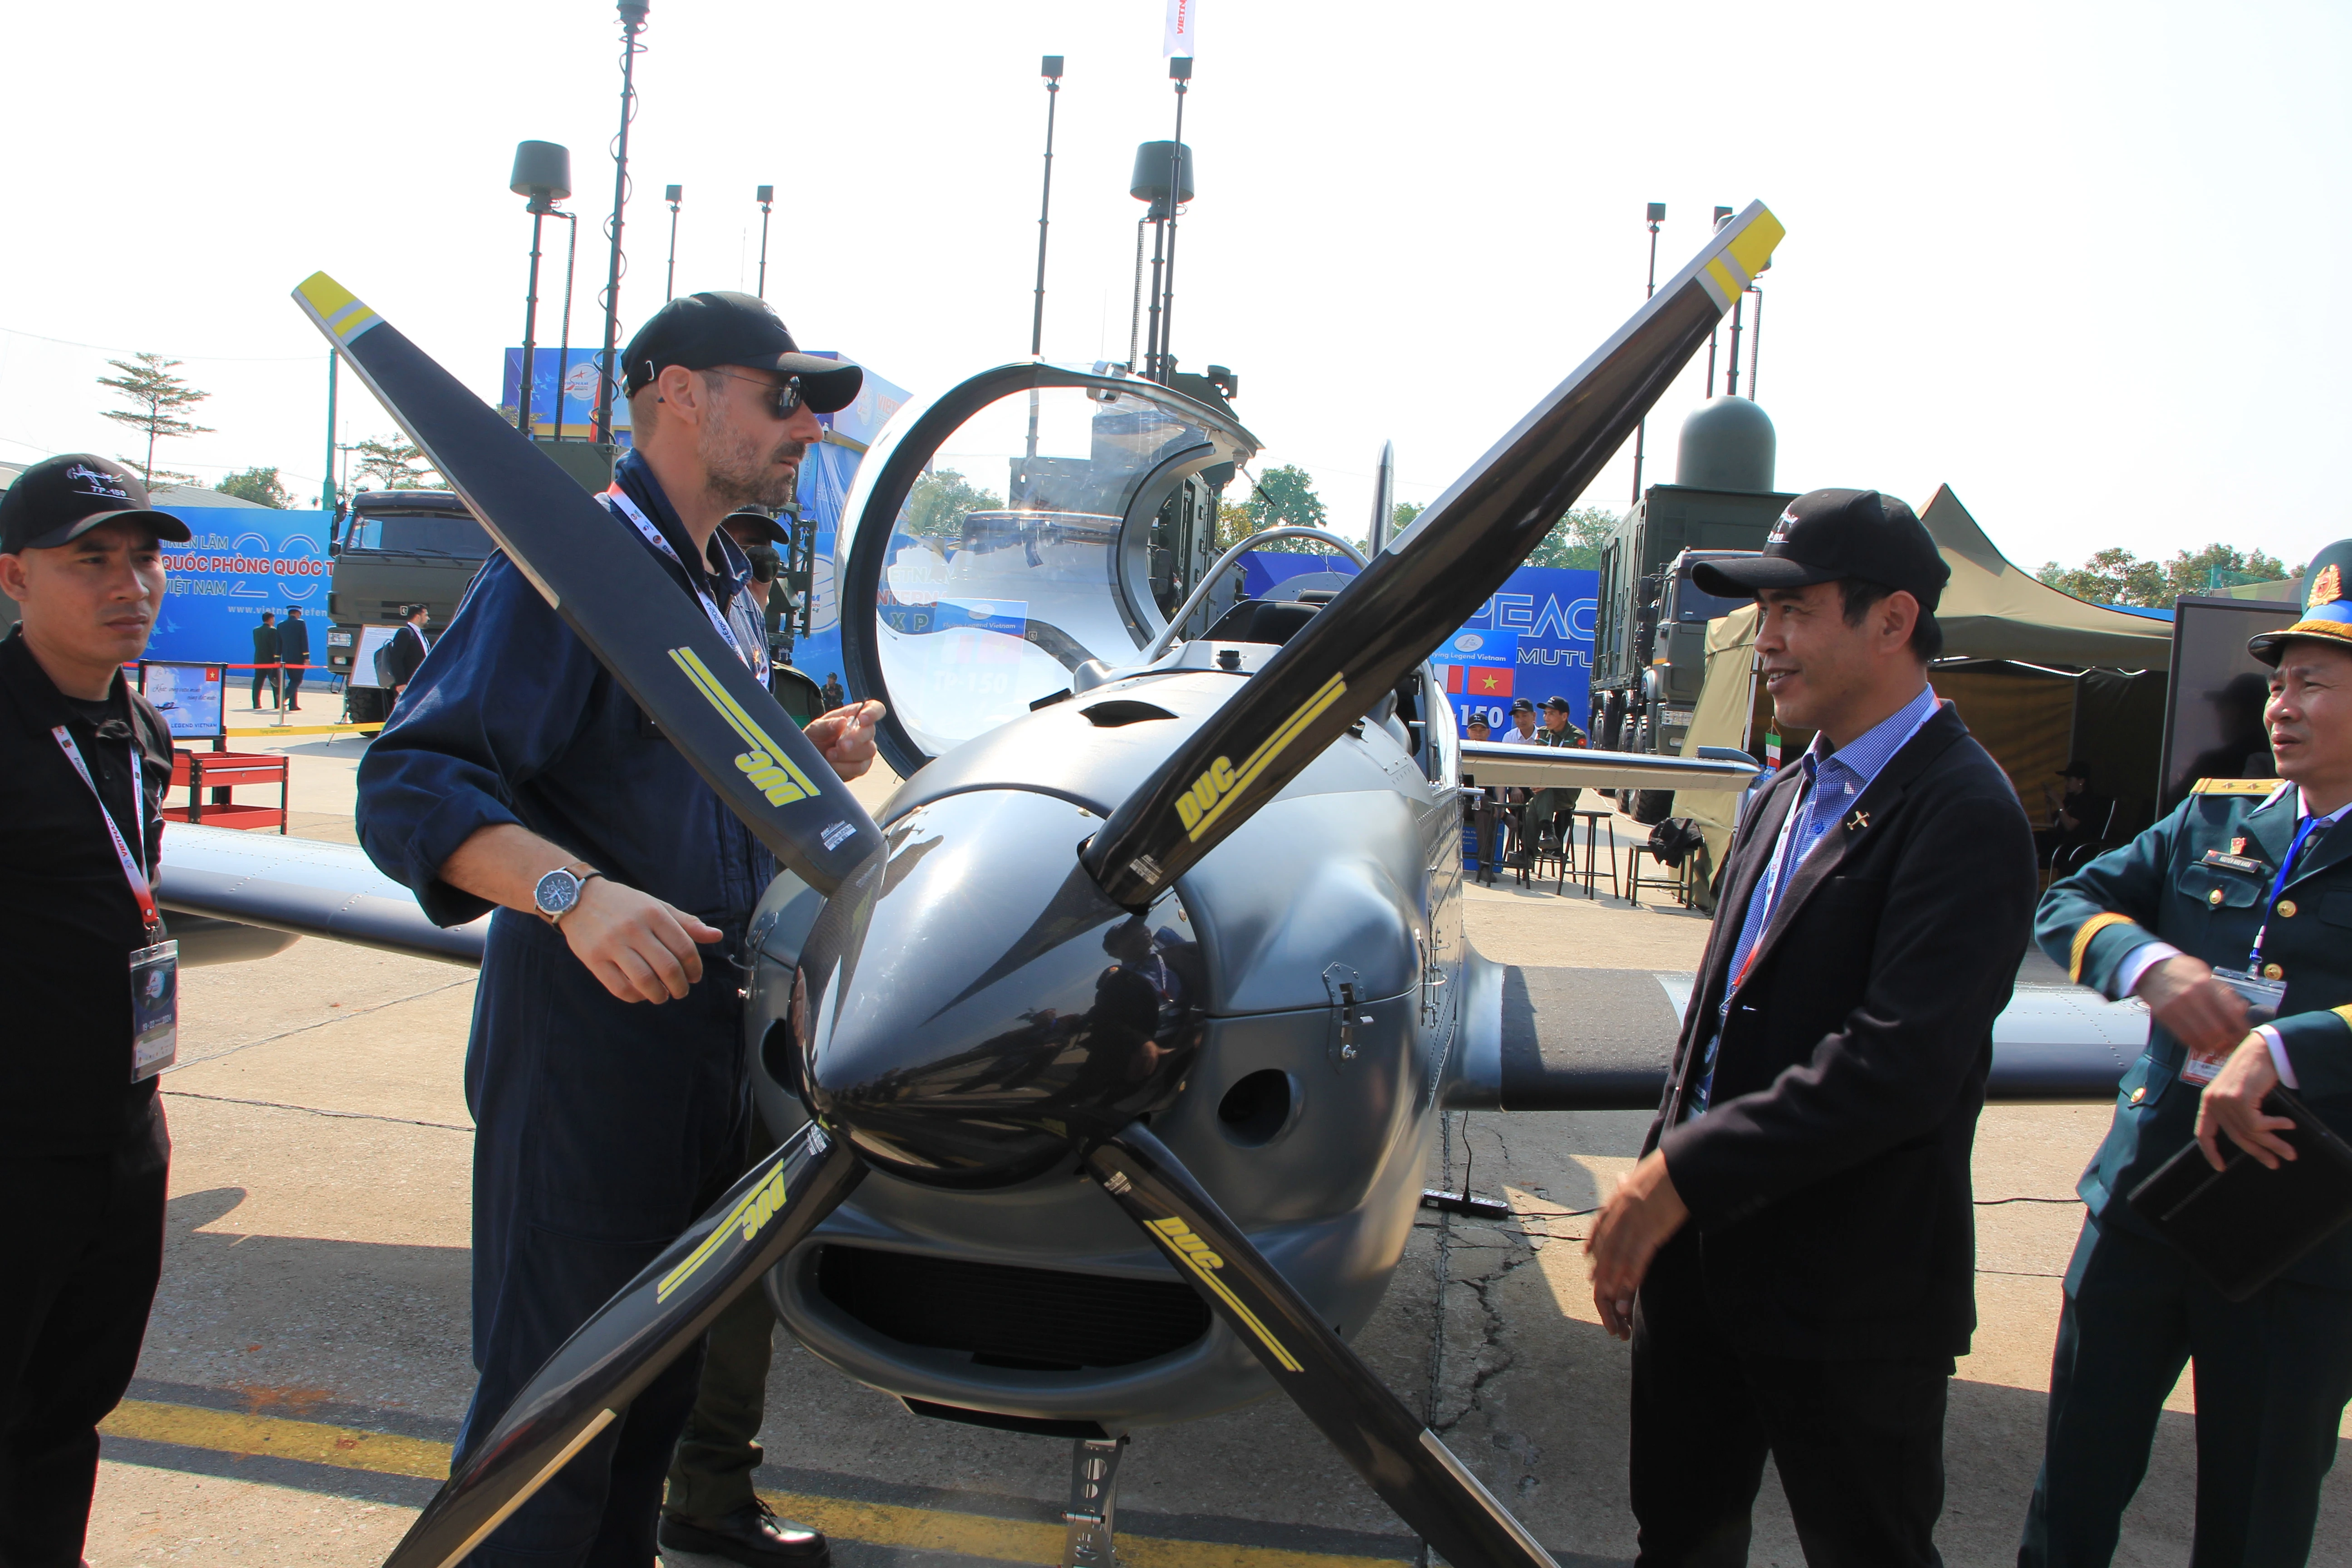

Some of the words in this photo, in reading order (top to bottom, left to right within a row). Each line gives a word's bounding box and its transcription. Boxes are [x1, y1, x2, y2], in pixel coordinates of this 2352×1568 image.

[201, 533, 229, 550] LÃM
[162, 551, 209, 573] QUỐC
[211, 553, 270, 575] PHÒNG
[273, 555, 323, 577] QUỐC
[194, 579, 227, 596] NAM
[1477, 653, 1506, 662] Vietnam
[735, 750, 806, 807] DUC
[1175, 756, 1237, 831] DUC
[742, 1171, 787, 1241] DUC
[1153, 1216, 1224, 1269] DUC
